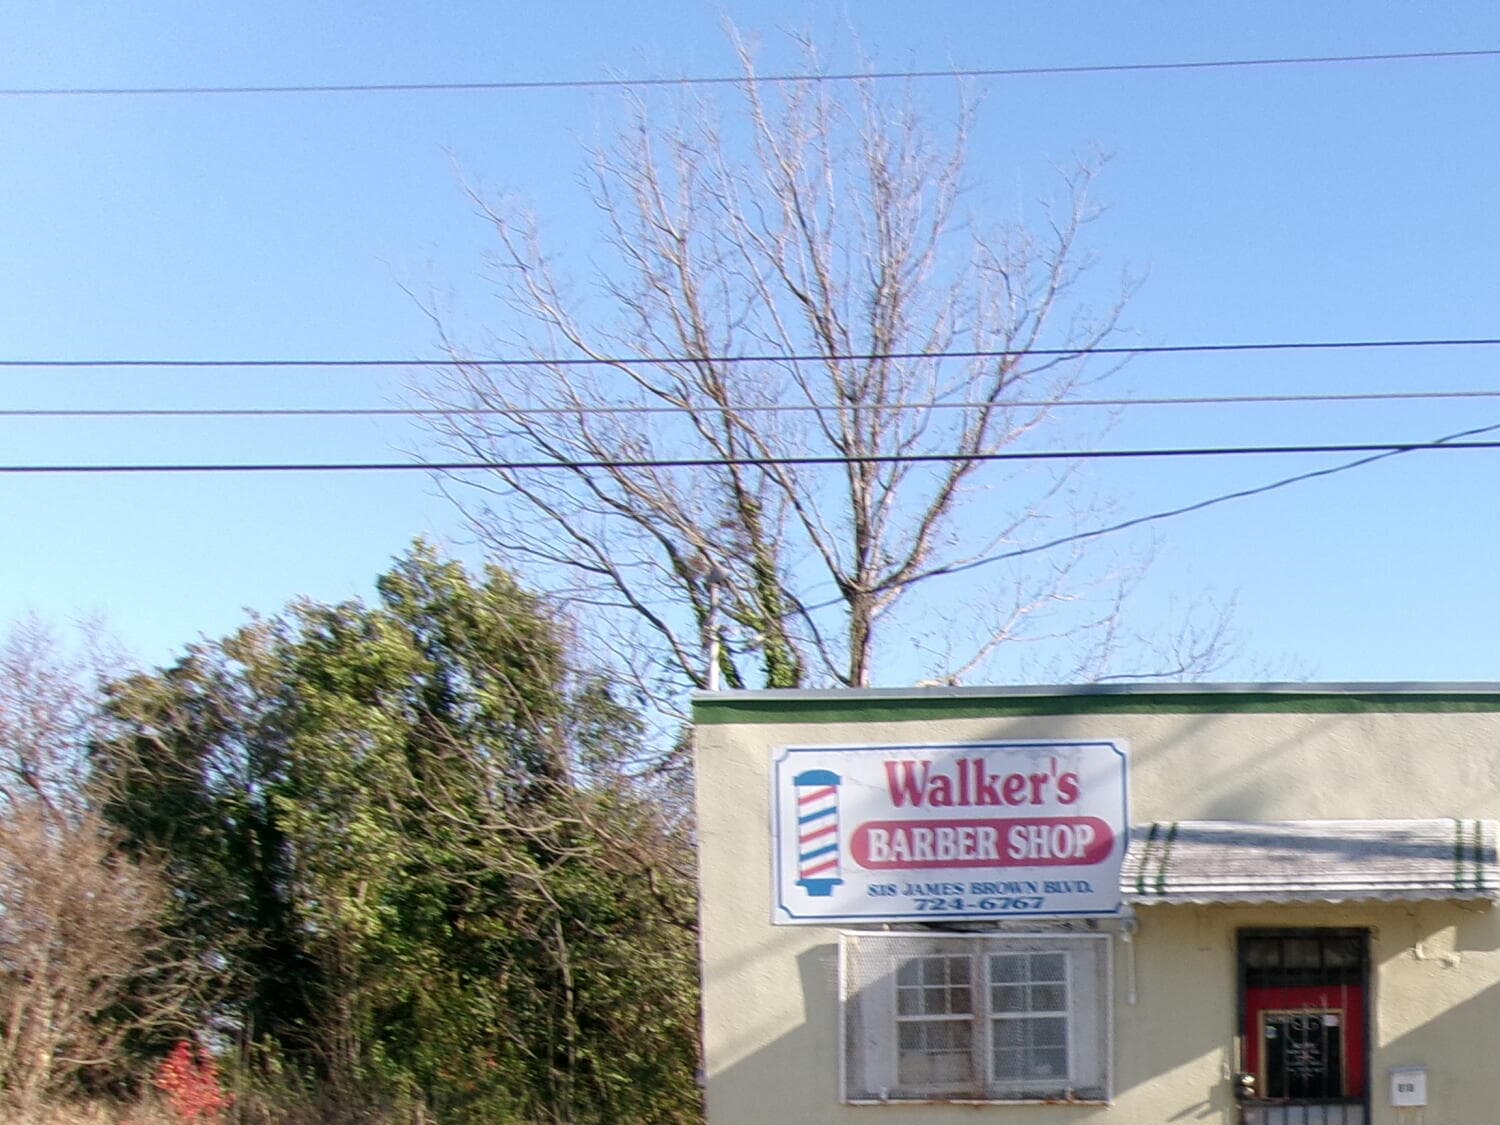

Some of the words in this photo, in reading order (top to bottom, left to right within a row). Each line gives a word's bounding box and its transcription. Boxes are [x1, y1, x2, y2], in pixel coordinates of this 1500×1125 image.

[884, 756, 1081, 808] Walker's
[867, 826, 998, 863] BARBER
[1008, 823, 1095, 859] SHOP
[902, 882, 964, 896] JAMES
[970, 881, 1038, 894] BROWN
[913, 896, 1045, 911] 724-6767
